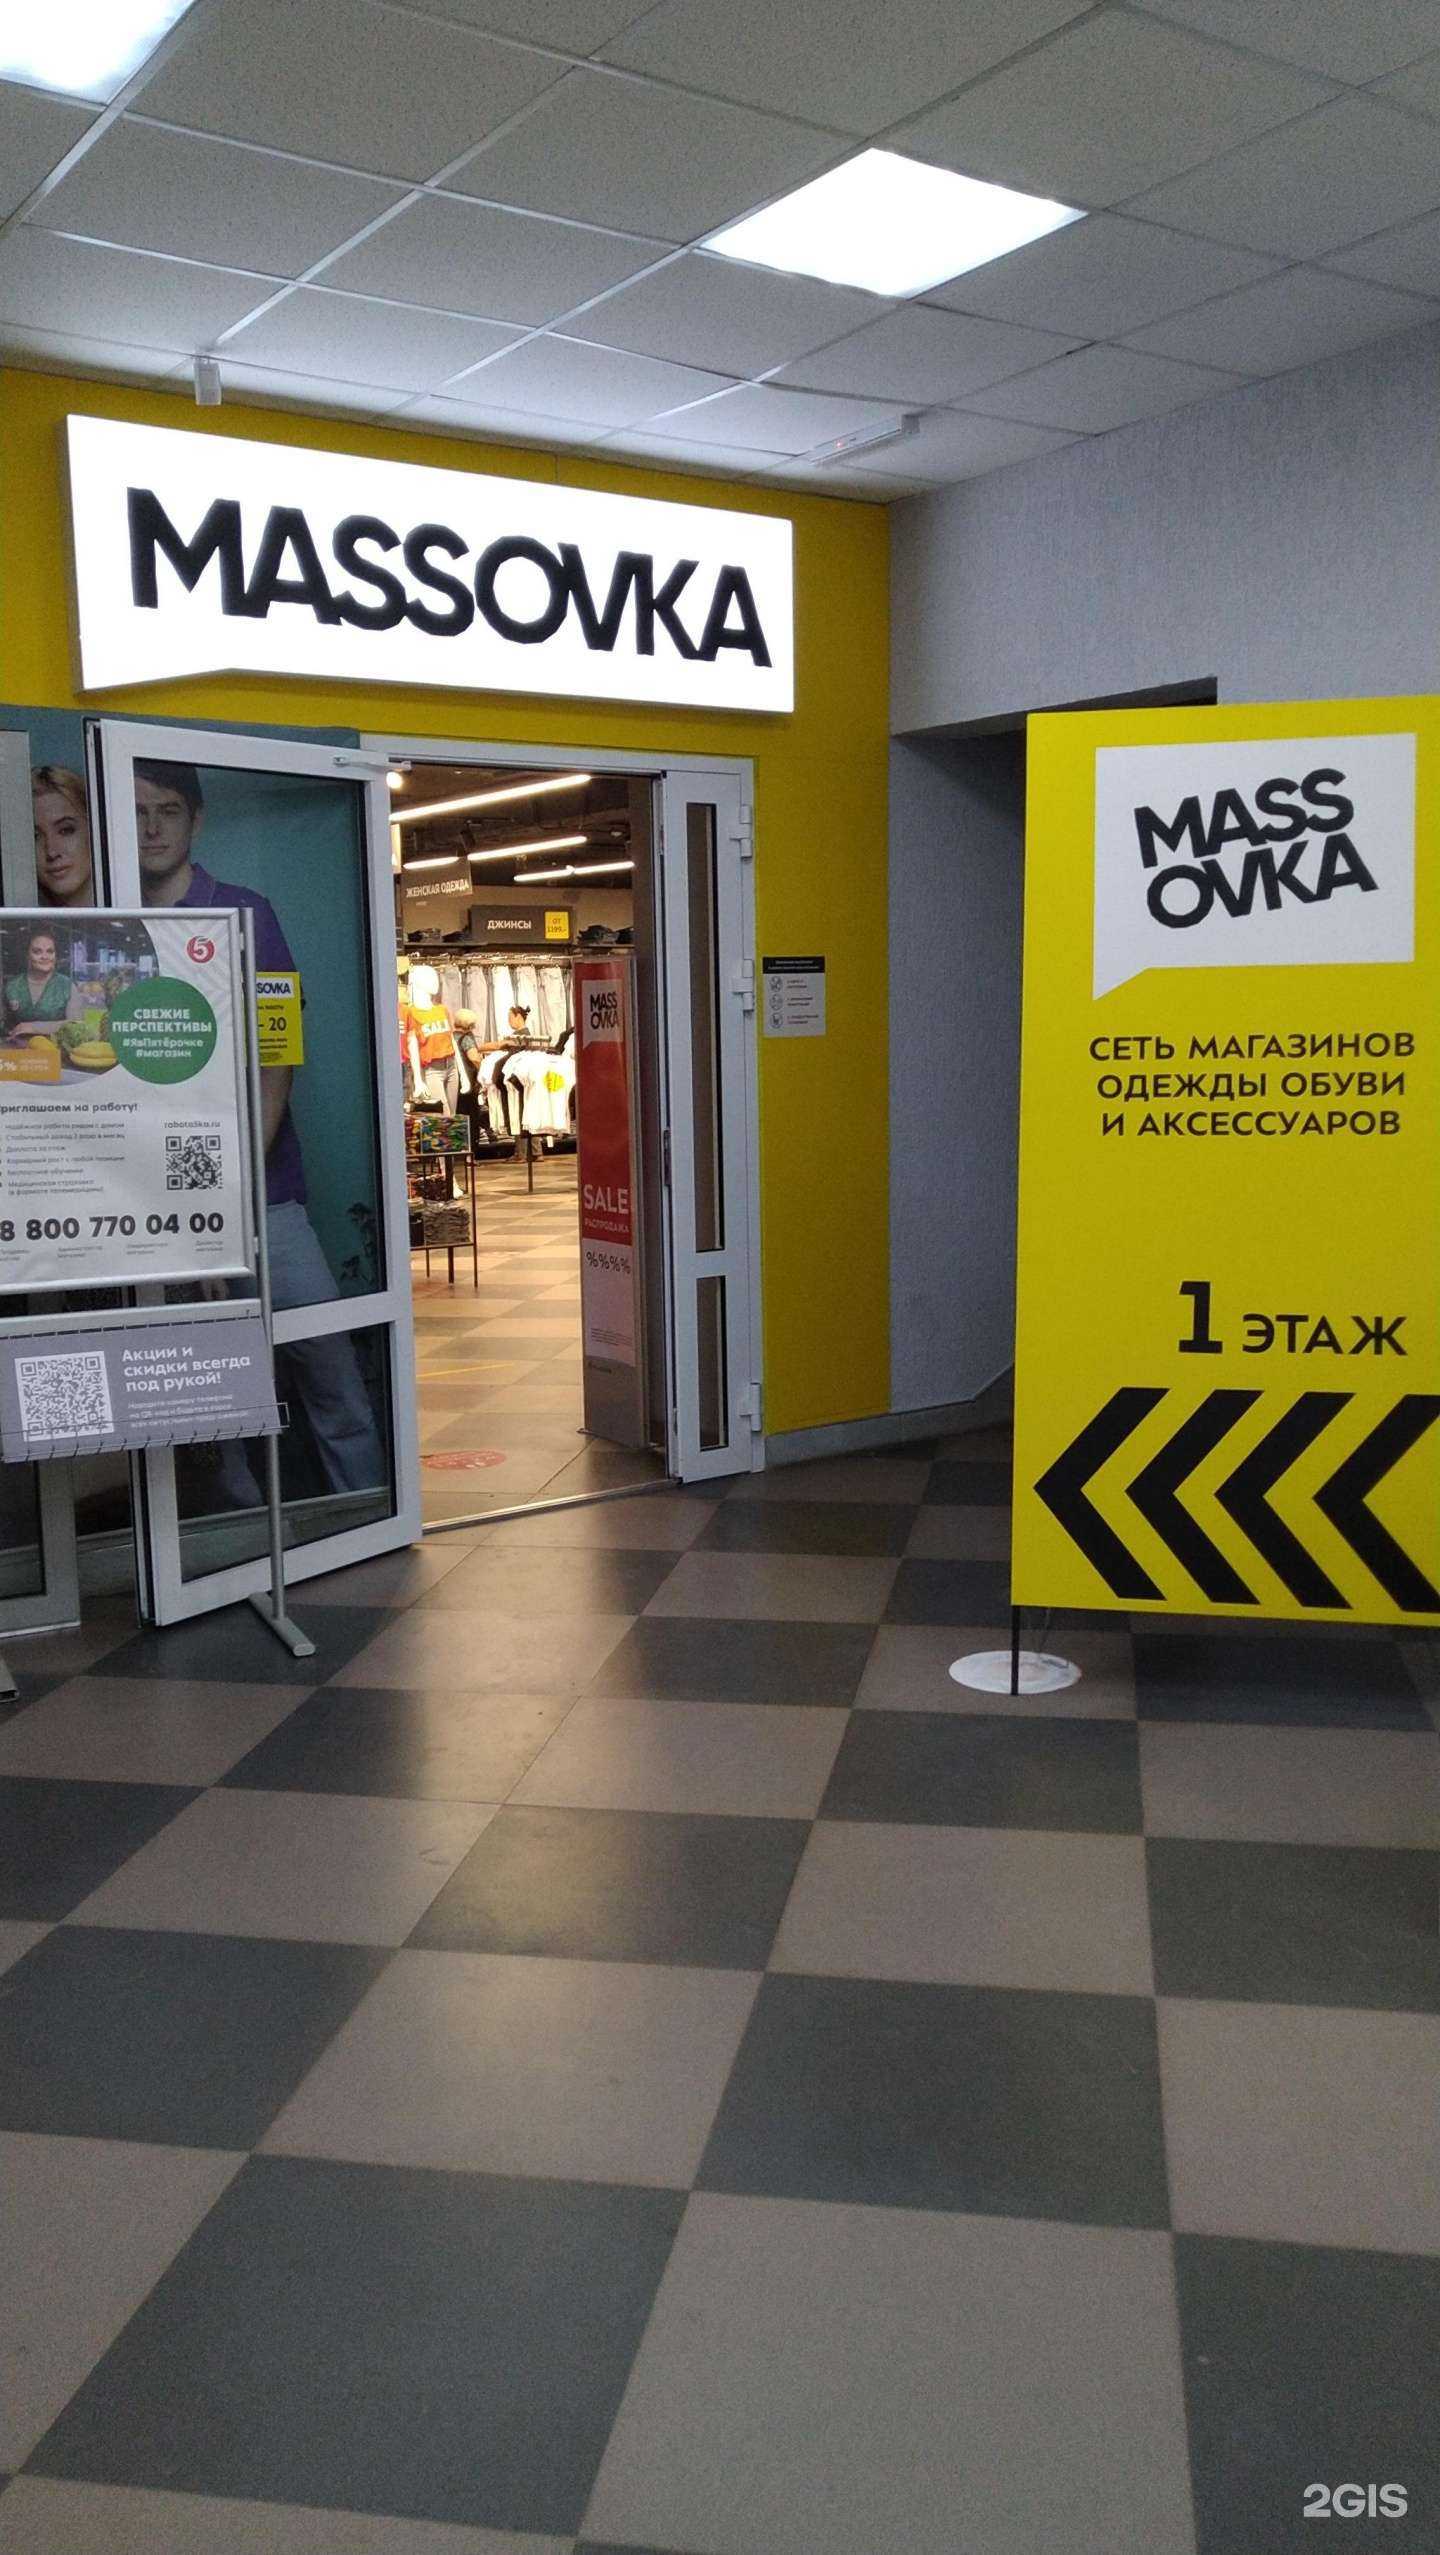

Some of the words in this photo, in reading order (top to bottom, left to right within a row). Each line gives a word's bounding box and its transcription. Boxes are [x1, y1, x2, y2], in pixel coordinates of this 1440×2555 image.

[127, 487, 772, 668] MASSOVKA
[1135, 768, 1355, 868] MASS
[1146, 833, 1379, 929] OVKA
[488, 920, 532, 930] ДЖИНСЫ
[256, 982, 291, 994] SOVKA
[590, 991, 617, 1012] MASS
[133, 1008, 190, 1020] СВЕЖИЕ
[269, 1016, 287, 1031] 20
[112, 1021, 212, 1033] ПЕРСПЕКТИВЫ
[136, 1049, 192, 1058] #магазин
[1089, 1036, 1176, 1061] СЕТЬ
[1188, 1032, 1416, 1060] МАГАЗИНОВ
[1097, 1073, 1267, 1102] ОДЕЖДЫ
[1281, 1071, 1406, 1097] ОБУВИ
[0, 1105, 71, 1114] риглашаем
[92, 1102, 138, 1114] работу!
[1102, 1112, 1125, 1136] И
[1137, 1110, 1401, 1136] АКСЕССУАРОВ
[583, 1184, 629, 1214] SALE
[0, 1220, 16, 1242] 8
[26, 1217, 80, 1240] 800
[89, 1215, 136, 1238] 770
[145, 1213, 180, 1236] 04
[189, 1212, 224, 1234] 00
[1179, 1280, 1224, 1354] 1
[1242, 1314, 1408, 1356] ЭТАЖ
[122, 1347, 178, 1362] Акции
[181, 1346, 194, 1357] и
[123, 1362, 189, 1377] скидки
[192, 1356, 252, 1370] всегда
[126, 1380, 160, 1392] под
[163, 1372, 222, 1392] рукой!
